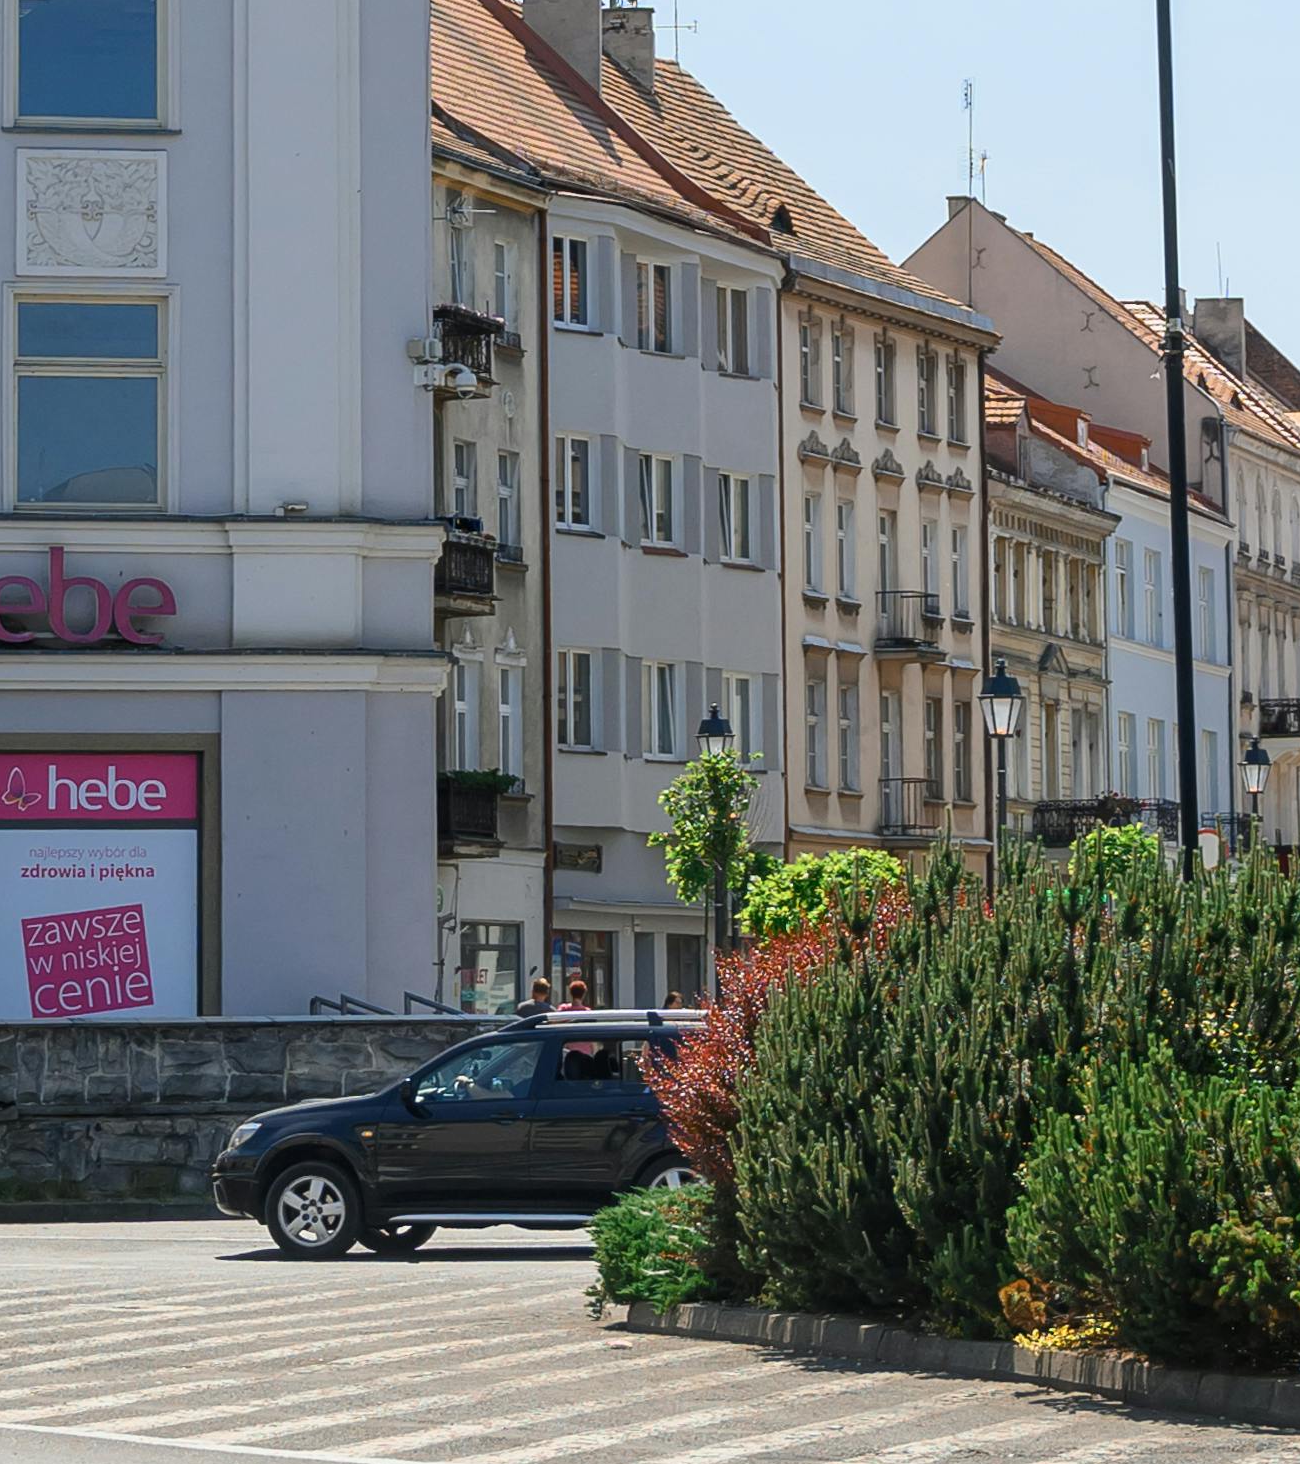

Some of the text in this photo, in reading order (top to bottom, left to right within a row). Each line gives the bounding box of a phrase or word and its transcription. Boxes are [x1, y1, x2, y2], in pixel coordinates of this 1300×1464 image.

[48, 765, 167, 811] hebe
[29, 846, 147, 861] najlepszy wybór dla
[21, 864, 155, 882] zdrowia i piękna
[27, 911, 141, 947] zawsze
[30, 937, 142, 975] w niskiej
[34, 965, 150, 1014] cenie
